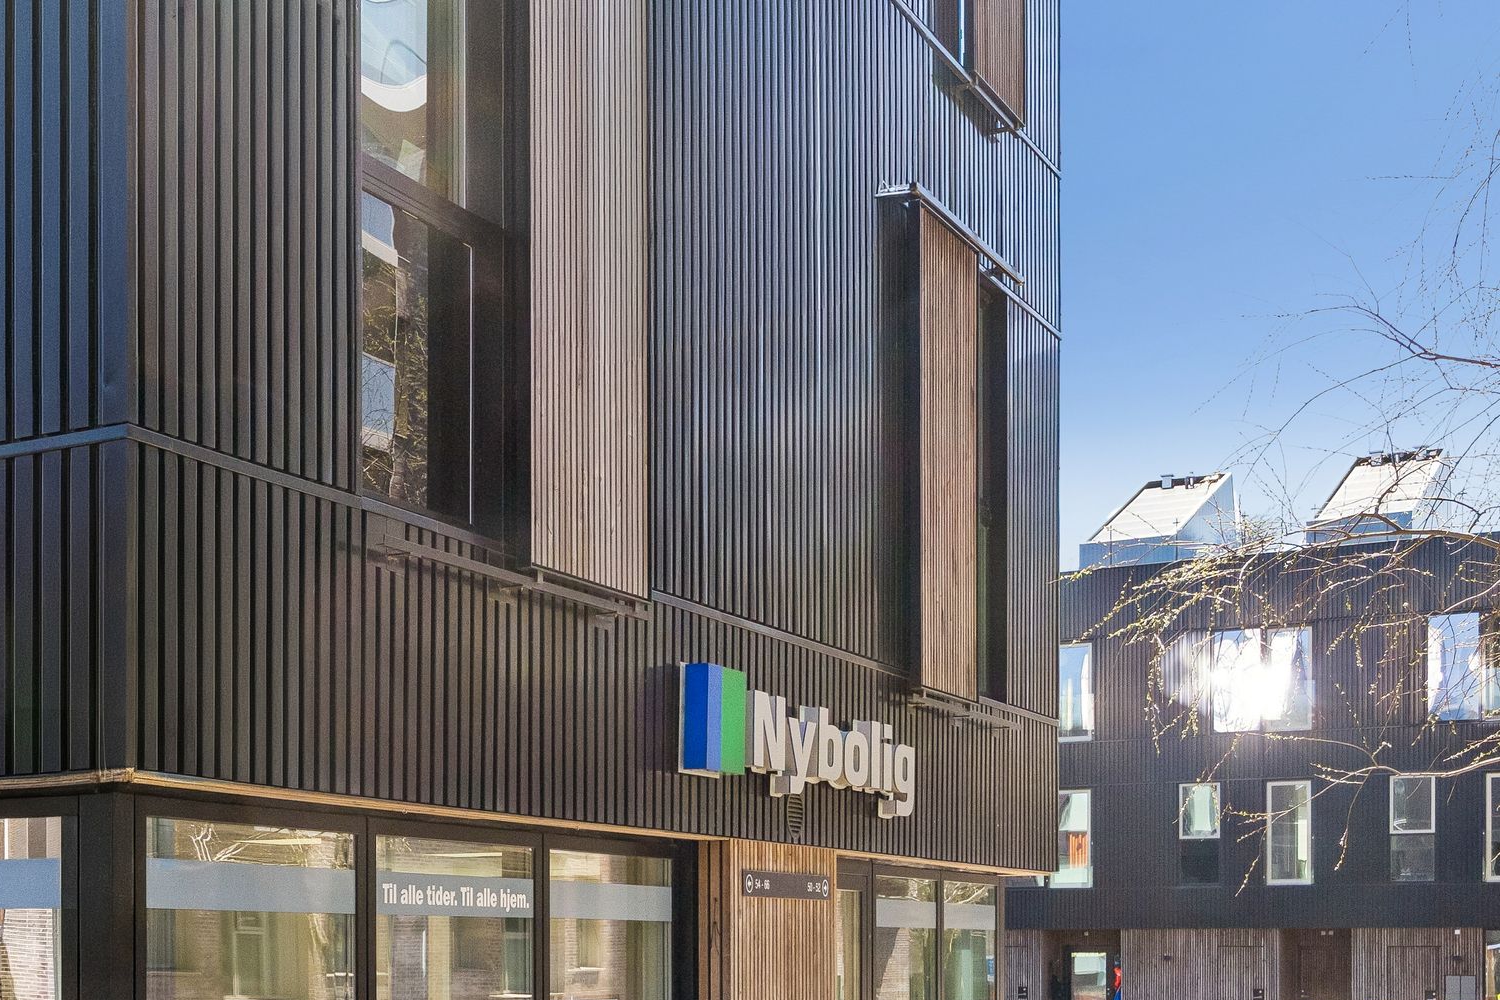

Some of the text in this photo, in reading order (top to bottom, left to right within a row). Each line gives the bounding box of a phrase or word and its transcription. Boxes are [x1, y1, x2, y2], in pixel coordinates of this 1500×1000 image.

[750, 689, 916, 817] Nybolig
[382, 883, 530, 912] Til alle tider. Til alle hjem.
